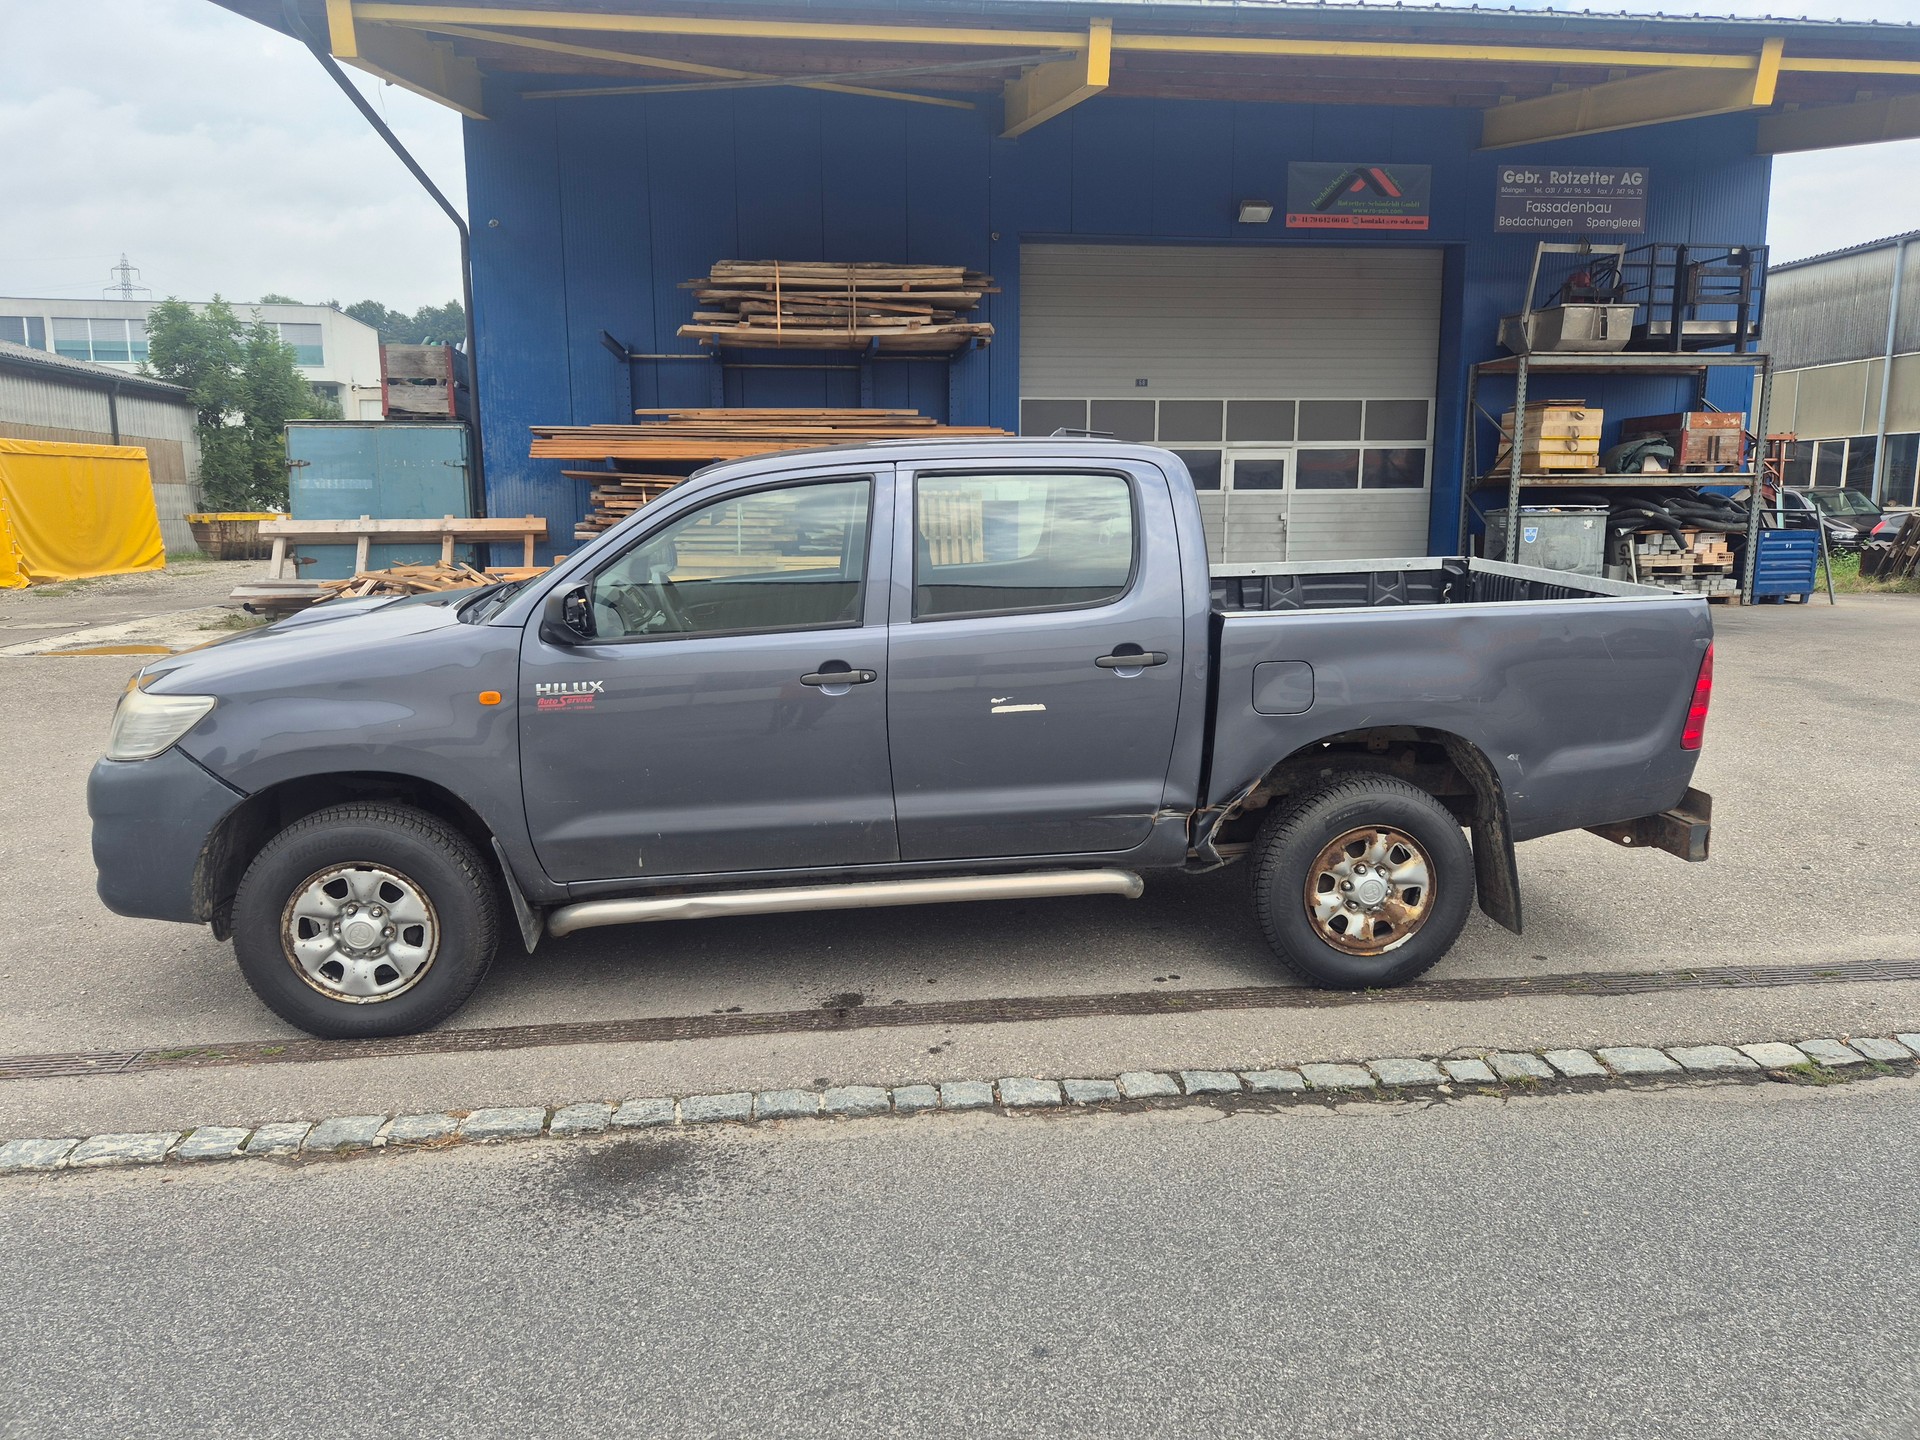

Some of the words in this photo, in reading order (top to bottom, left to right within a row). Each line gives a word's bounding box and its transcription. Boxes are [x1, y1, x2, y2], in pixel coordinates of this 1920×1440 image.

[1503, 170, 1543, 184] Gebr.
[1550, 171, 1615, 185] Rotzetter
[1621, 172, 1643, 185] AG
[1526, 201, 1612, 214] Fassadenbau
[1499, 216, 1573, 228] Bedachungen
[1586, 217, 1641, 229] Spenglerei
[535, 680, 605, 696] HILUX
[537, 697, 559, 705] Auto
[559, 694, 594, 707] Service
